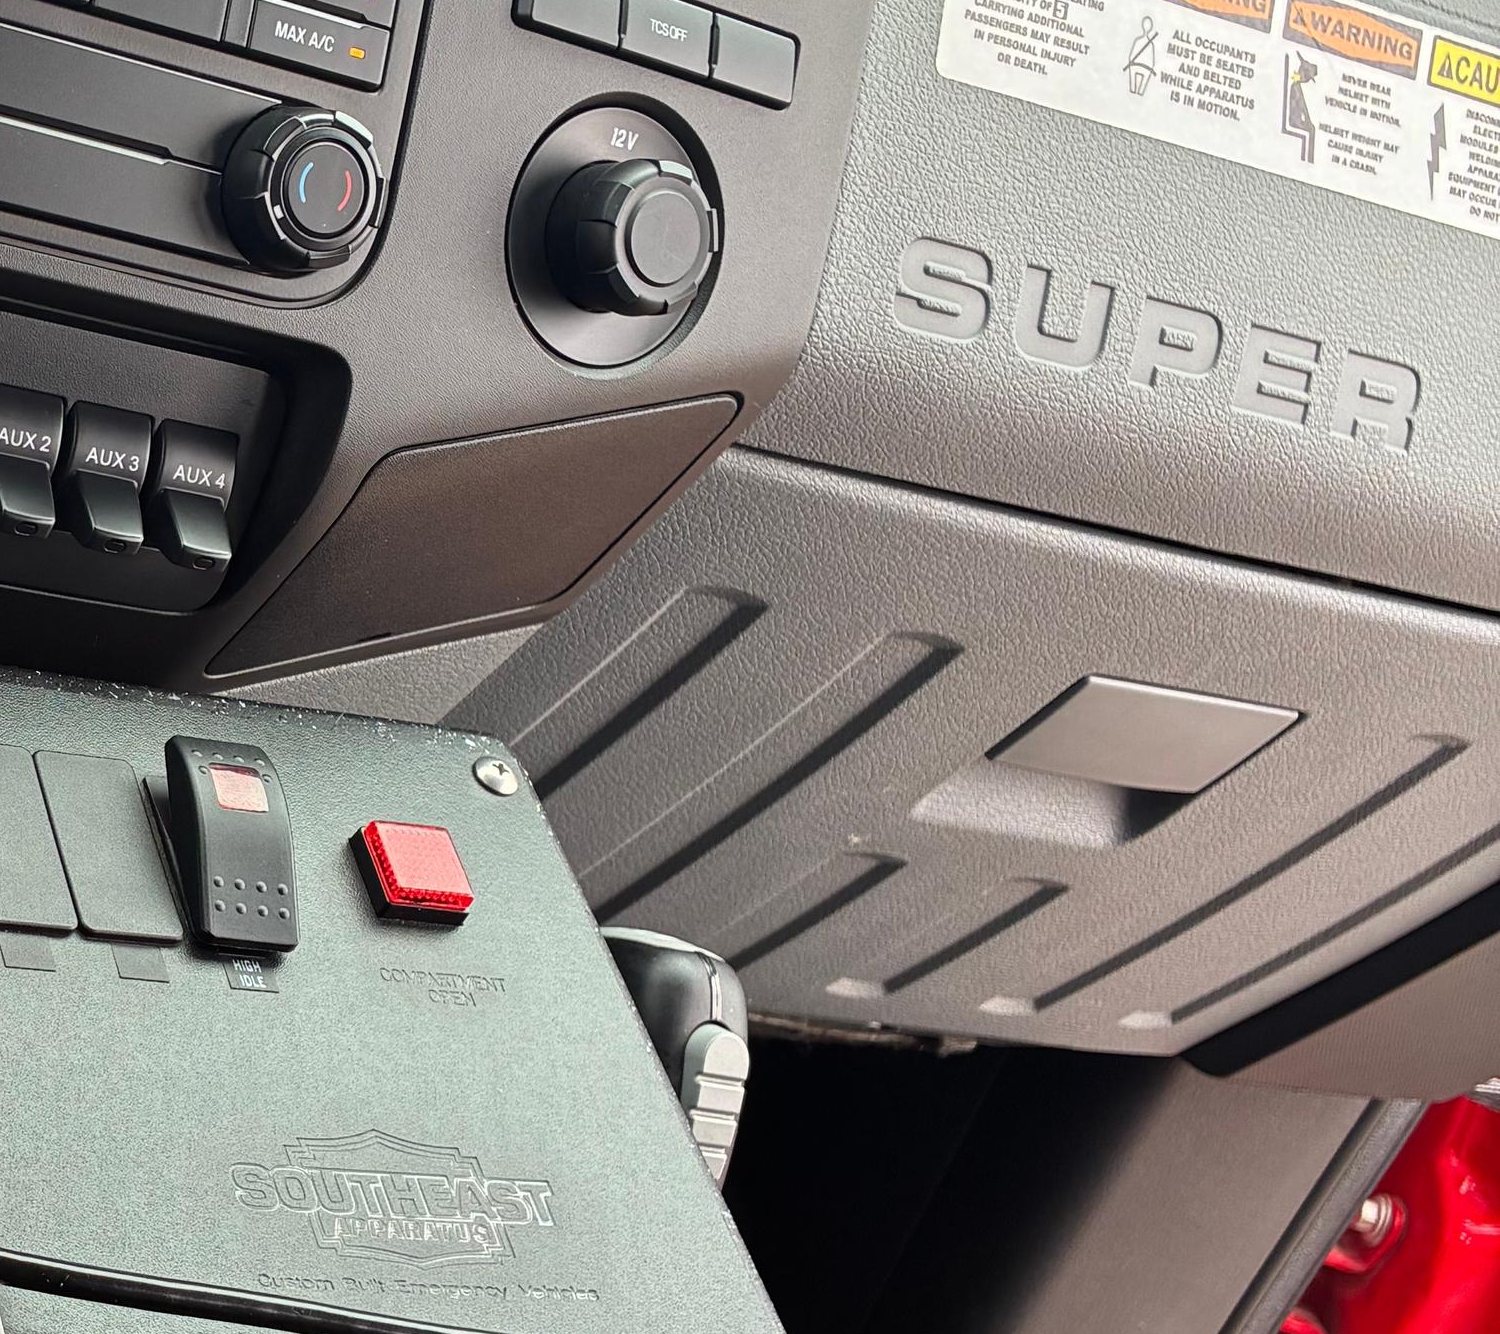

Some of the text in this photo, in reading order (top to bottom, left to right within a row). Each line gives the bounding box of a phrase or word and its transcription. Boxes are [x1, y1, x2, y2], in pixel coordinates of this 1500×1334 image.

[1040, 0, 1053, 11] OF
[274, 20, 336, 53] MAX A/C
[650, 18, 688, 42] TCS OFF
[964, 9, 1090, 55] PASSENGERS MAY RESULT
[1027, 12, 1085, 38] ADDITIONAL
[1310, 10, 1414, 61] WARNING
[973, 28, 1077, 68] IN PERSONAL INJURY
[997, 52, 1011, 63] OR
[1172, 29, 1256, 64] ALL OCCUPANTS
[1166, 42, 1255, 79] MUST BE SEATED
[1178, 62, 1242, 90] AND BELTED
[1455, 56, 1500, 94] CAU
[1160, 71, 1255, 110] WHILE APPARATUS
[1169, 90, 1180, 102] IS
[1183, 95, 1195, 108] IN
[610, 127, 640, 151] 12V
[894, 234, 1422, 455] SUPER
[39, 435, 52, 452] 2
[85, 446, 140, 472] AUX 3
[172, 465, 226, 489] AUX 4
[232, 958, 262, 973] HIGH
[239, 974, 267, 989] IDLE
[379, 966, 506, 993] COMPARTMENT
[427, 988, 477, 1008] OPEN
[230, 1161, 555, 1227] SOUTHEAST
[333, 1217, 496, 1243] APPARATUS
